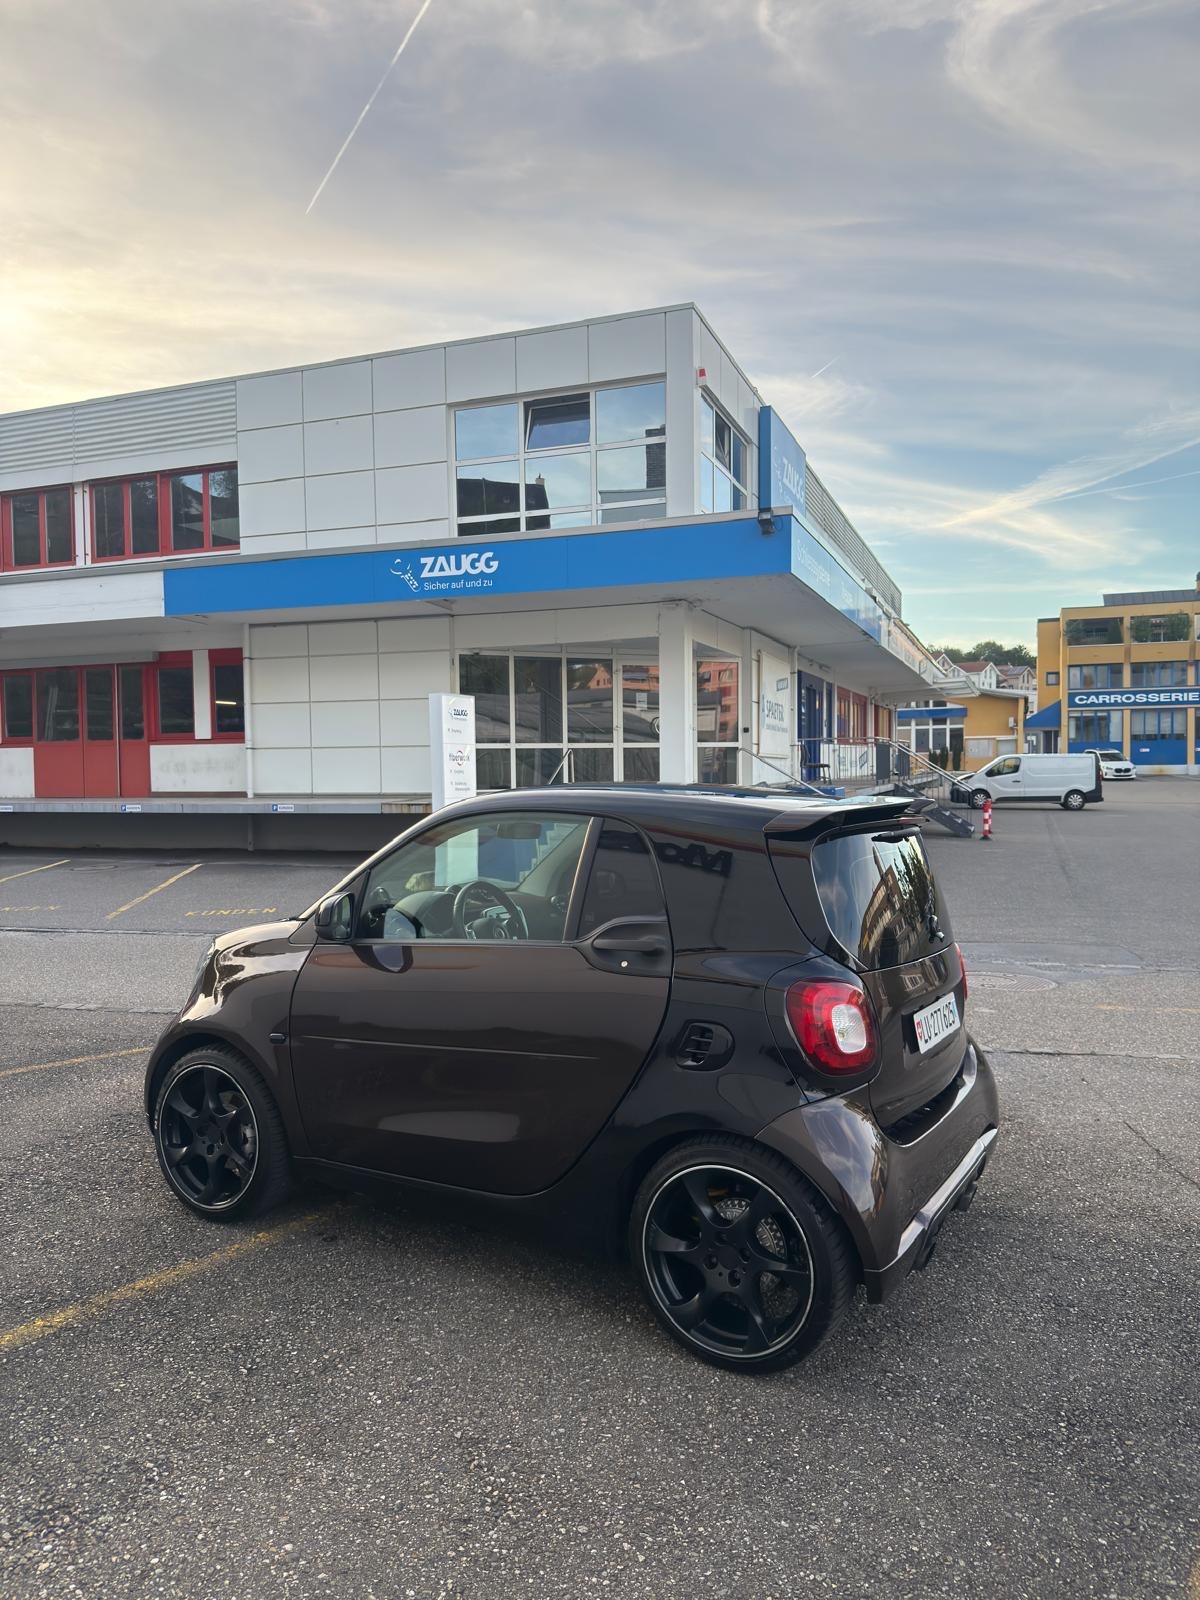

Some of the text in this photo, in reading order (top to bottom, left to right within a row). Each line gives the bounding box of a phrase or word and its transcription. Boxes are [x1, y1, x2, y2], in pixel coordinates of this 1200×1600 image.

[420, 552, 499, 578] ZAUGG
[423, 579, 493, 591] Sicher auf und zu
[1074, 692, 1200, 704] CARROSSERIE
[185, 907, 277, 917] KUNDEN
